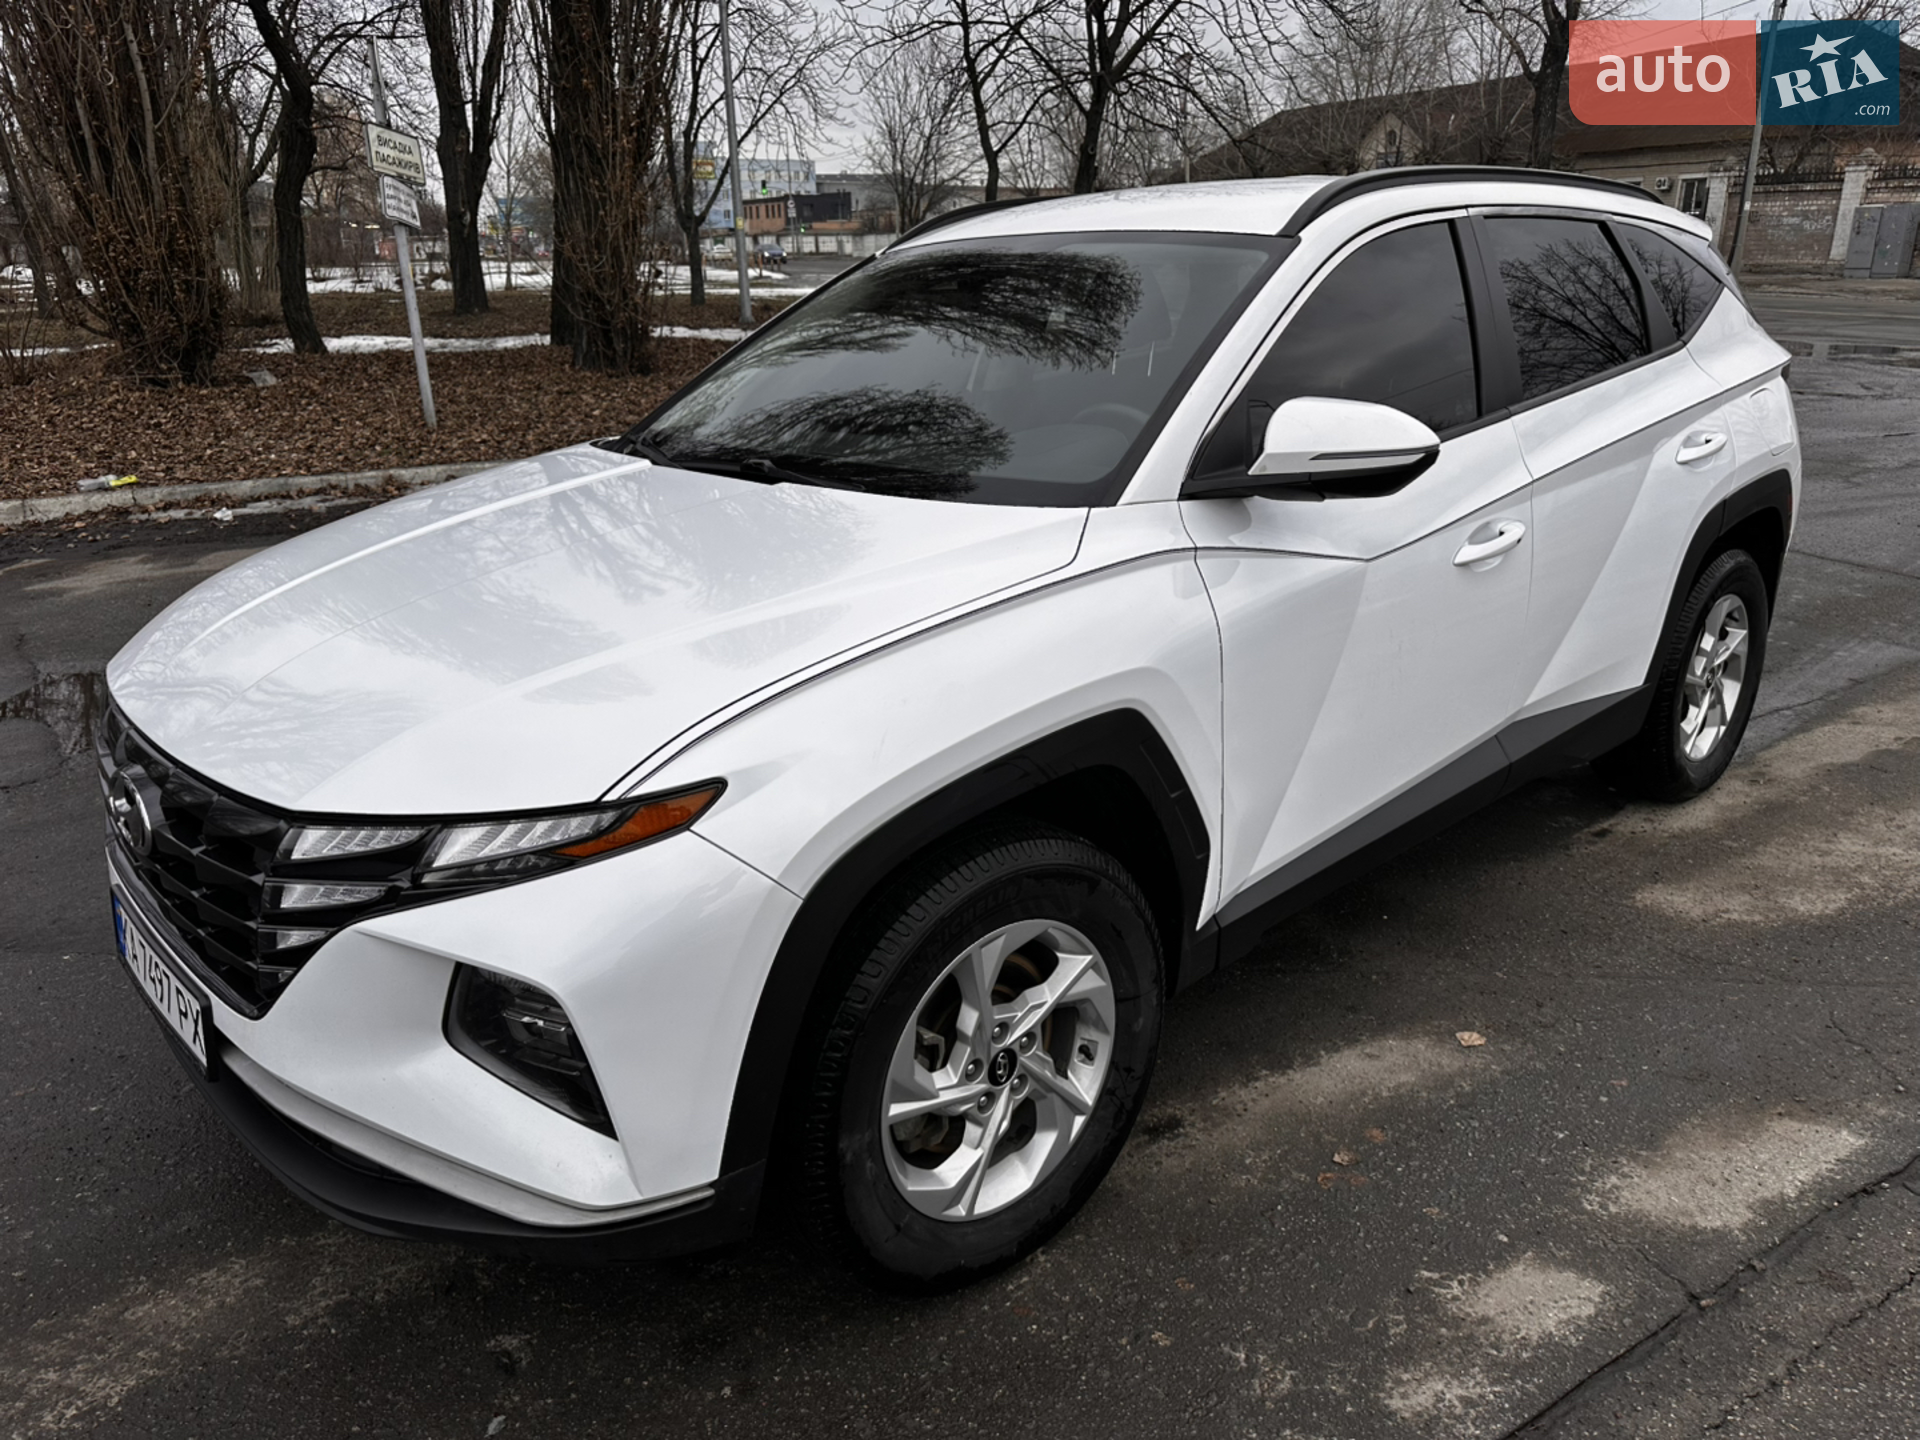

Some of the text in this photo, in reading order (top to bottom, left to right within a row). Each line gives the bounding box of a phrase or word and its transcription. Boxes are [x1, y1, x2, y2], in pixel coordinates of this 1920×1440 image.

[376, 134, 414, 157] ВИСАДКА
[375, 150, 421, 174] ПАСАЖИРІВ
[138, 938, 171, 1014] 7497
[175, 983, 206, 1058] PX
